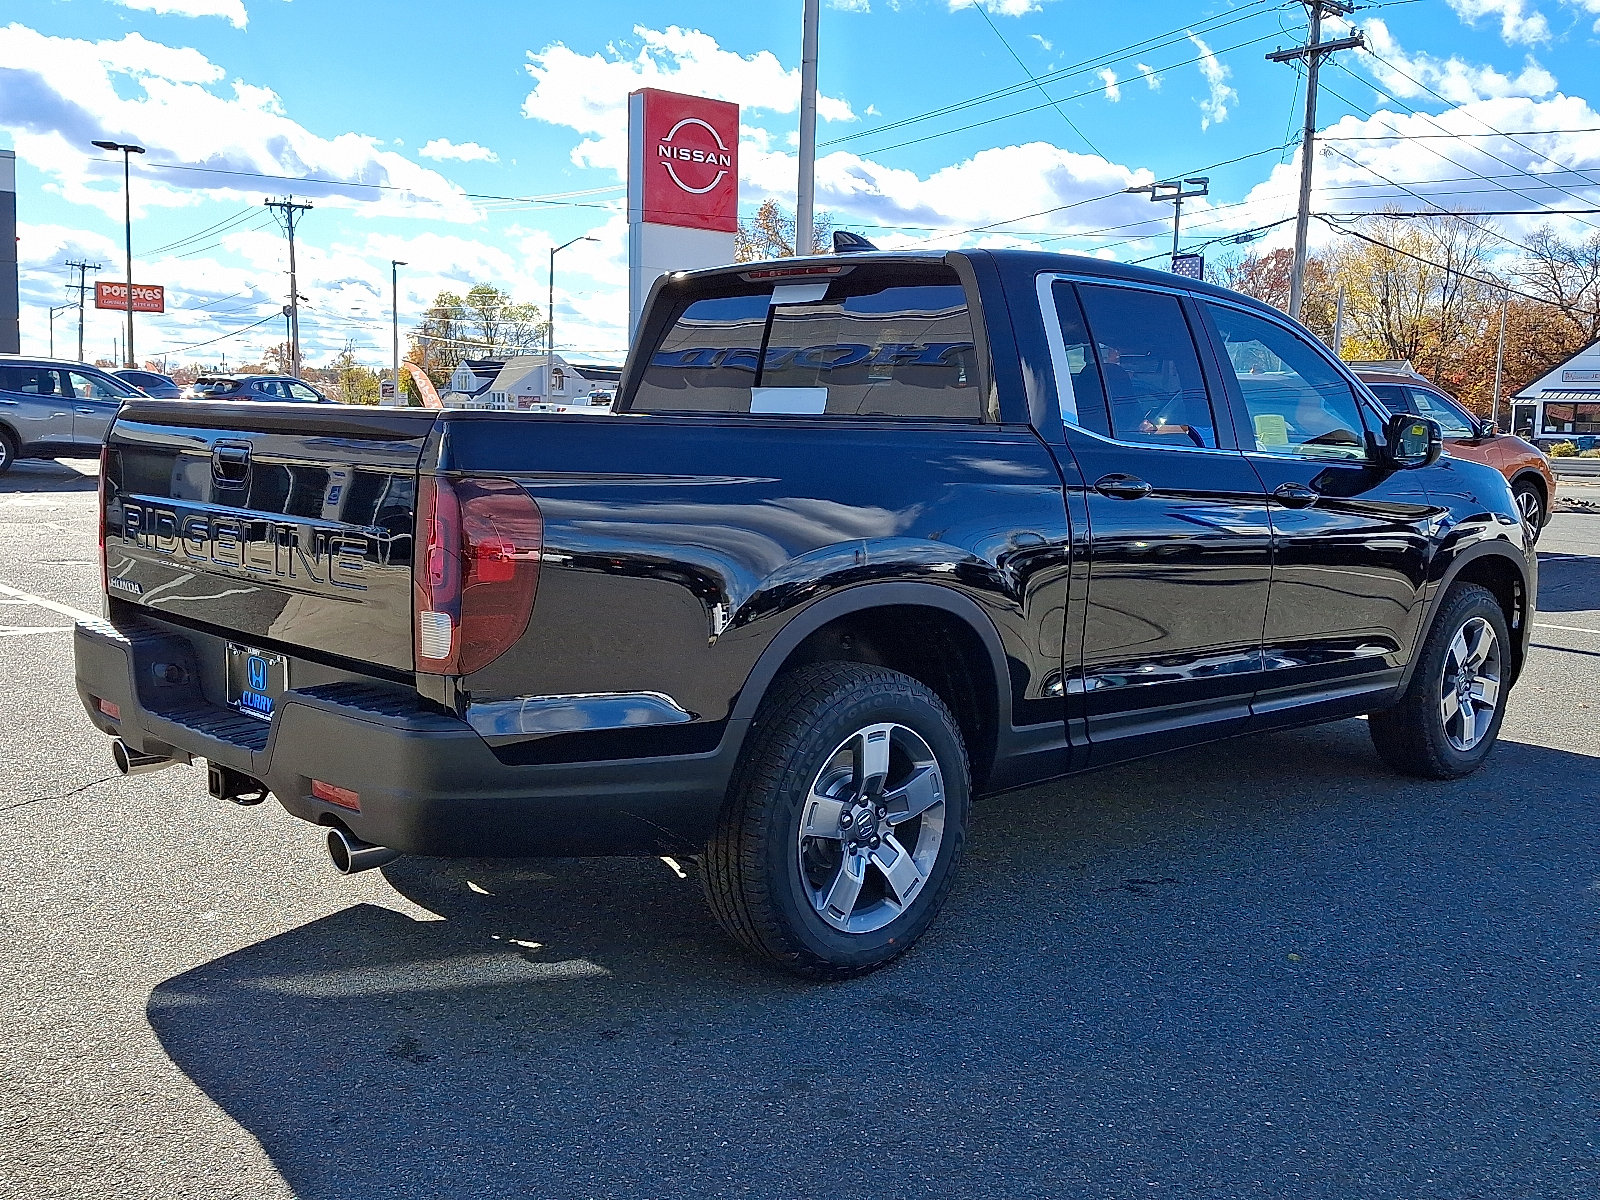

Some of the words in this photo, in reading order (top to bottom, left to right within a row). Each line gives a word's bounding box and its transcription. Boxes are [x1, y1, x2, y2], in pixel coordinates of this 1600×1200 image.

[658, 144, 731, 167] NISSAN
[122, 503, 368, 591] RIDGELINE
[110, 577, 142, 594] HONDA
[242, 690, 272, 712] CURRY
